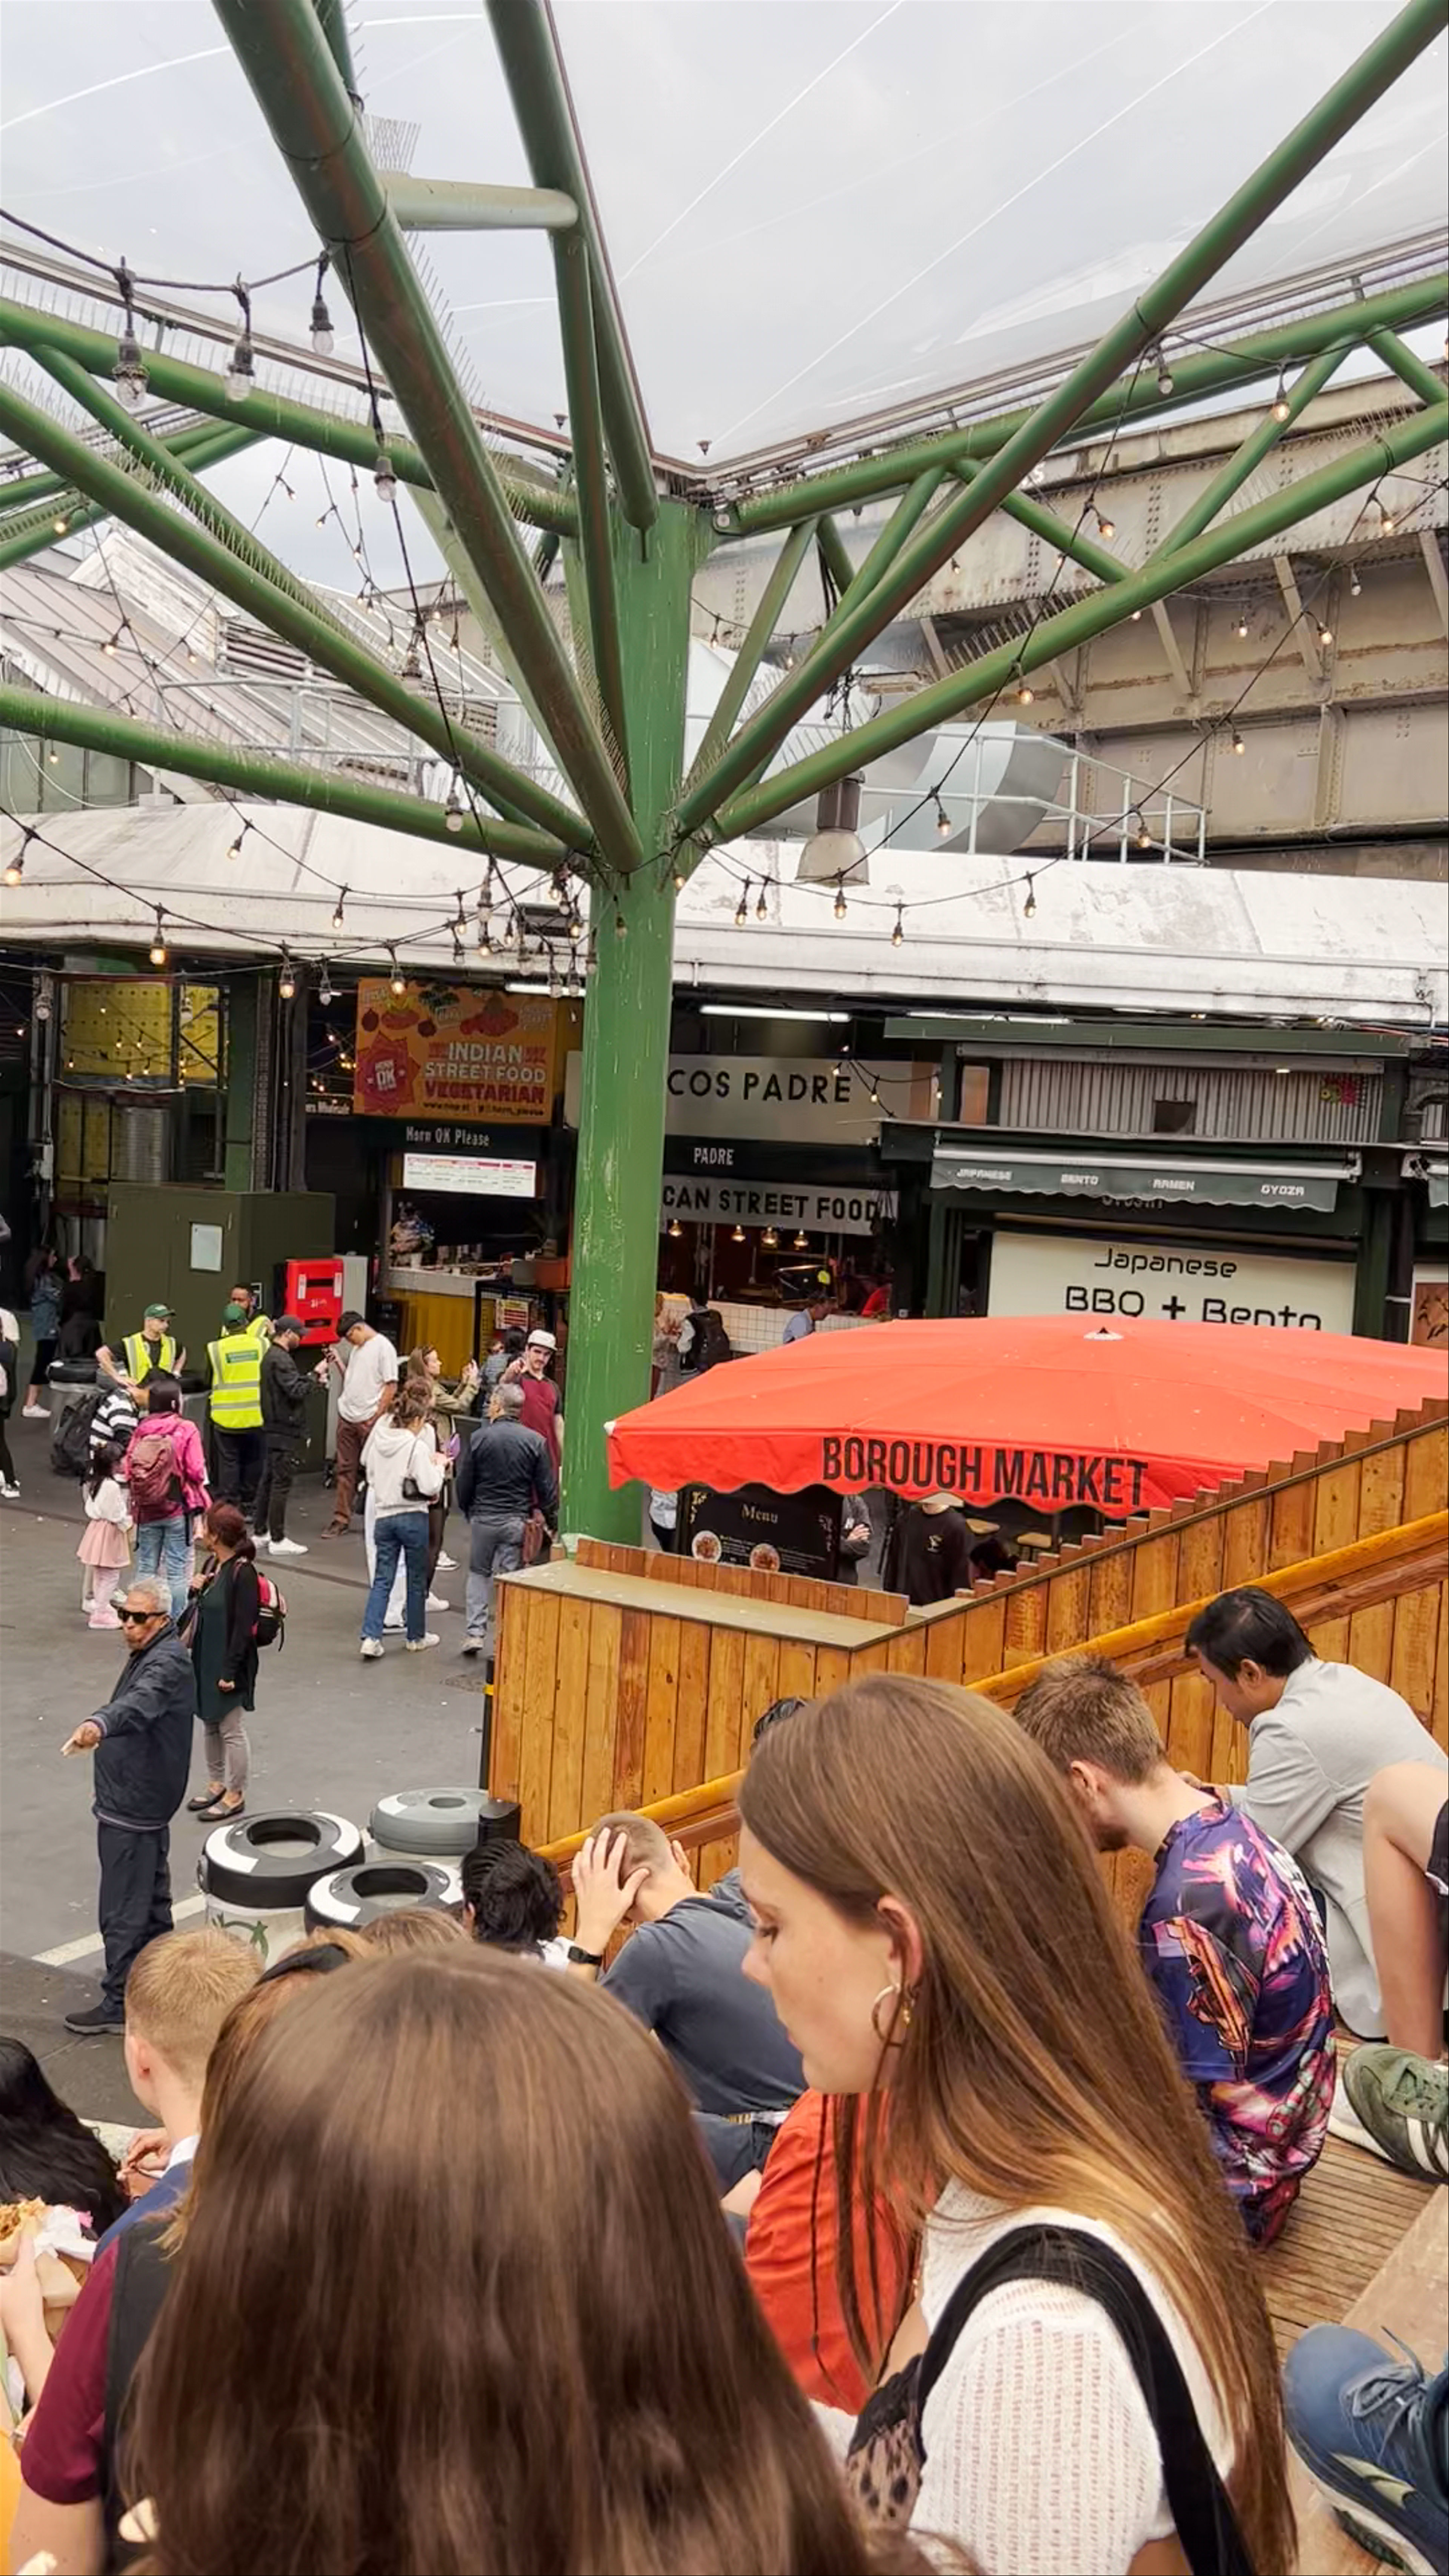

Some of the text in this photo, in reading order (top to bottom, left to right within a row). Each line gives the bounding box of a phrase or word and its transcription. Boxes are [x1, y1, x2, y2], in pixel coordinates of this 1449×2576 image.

[449, 1042, 521, 1063] INDIAN
[425, 1062, 546, 1083] STREET FOOD
[425, 1080, 545, 1104] VEGETARIAN
[667, 1070, 851, 1103] COS PADRE
[406, 1126, 490, 1146] Horn OK Please
[694, 1147, 734, 1166] PADRE
[957, 1168, 1304, 1196] JAPANESE BENTO RAMEN GYOZA
[663, 1186, 879, 1222] CAN STREET FOOD
[1095, 1248, 1237, 1278] Japanese
[1066, 1286, 1144, 1318] BBQ
[1161, 1296, 1186, 1320] +
[823, 1437, 1148, 1506] BOROUGH MARKET
[741, 1504, 778, 1524] Menu
